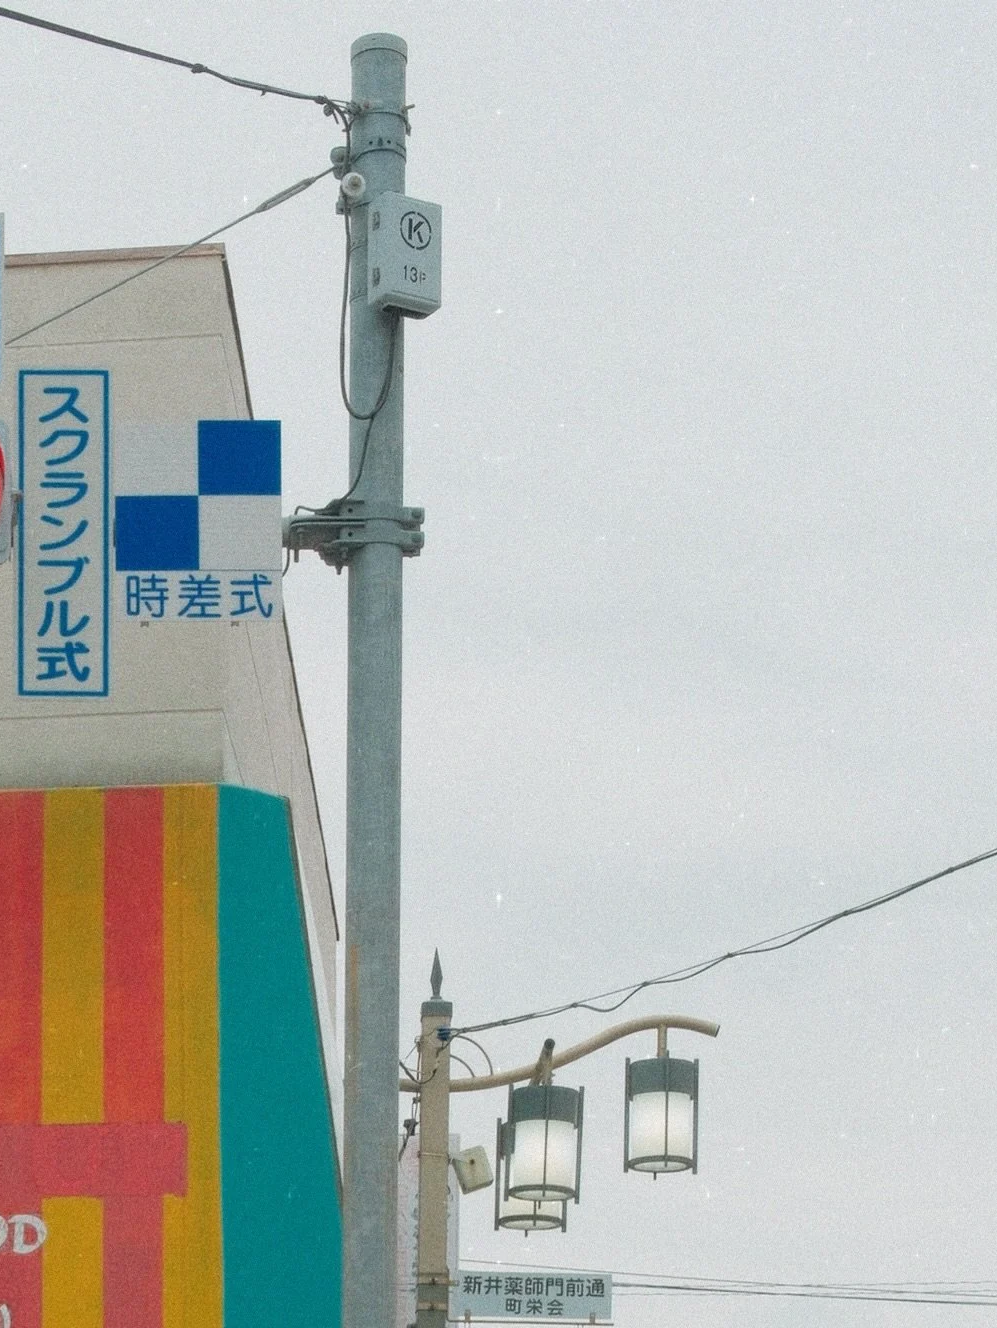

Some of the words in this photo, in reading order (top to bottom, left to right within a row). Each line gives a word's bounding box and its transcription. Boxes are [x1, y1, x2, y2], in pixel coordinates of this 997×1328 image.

[36, 386, 91, 682] スクランブル式
[125, 573, 274, 618] 時差式
[462, 1275, 605, 1298] 新井薬師門前通
[505, 1298, 564, 1316] 町栄会
